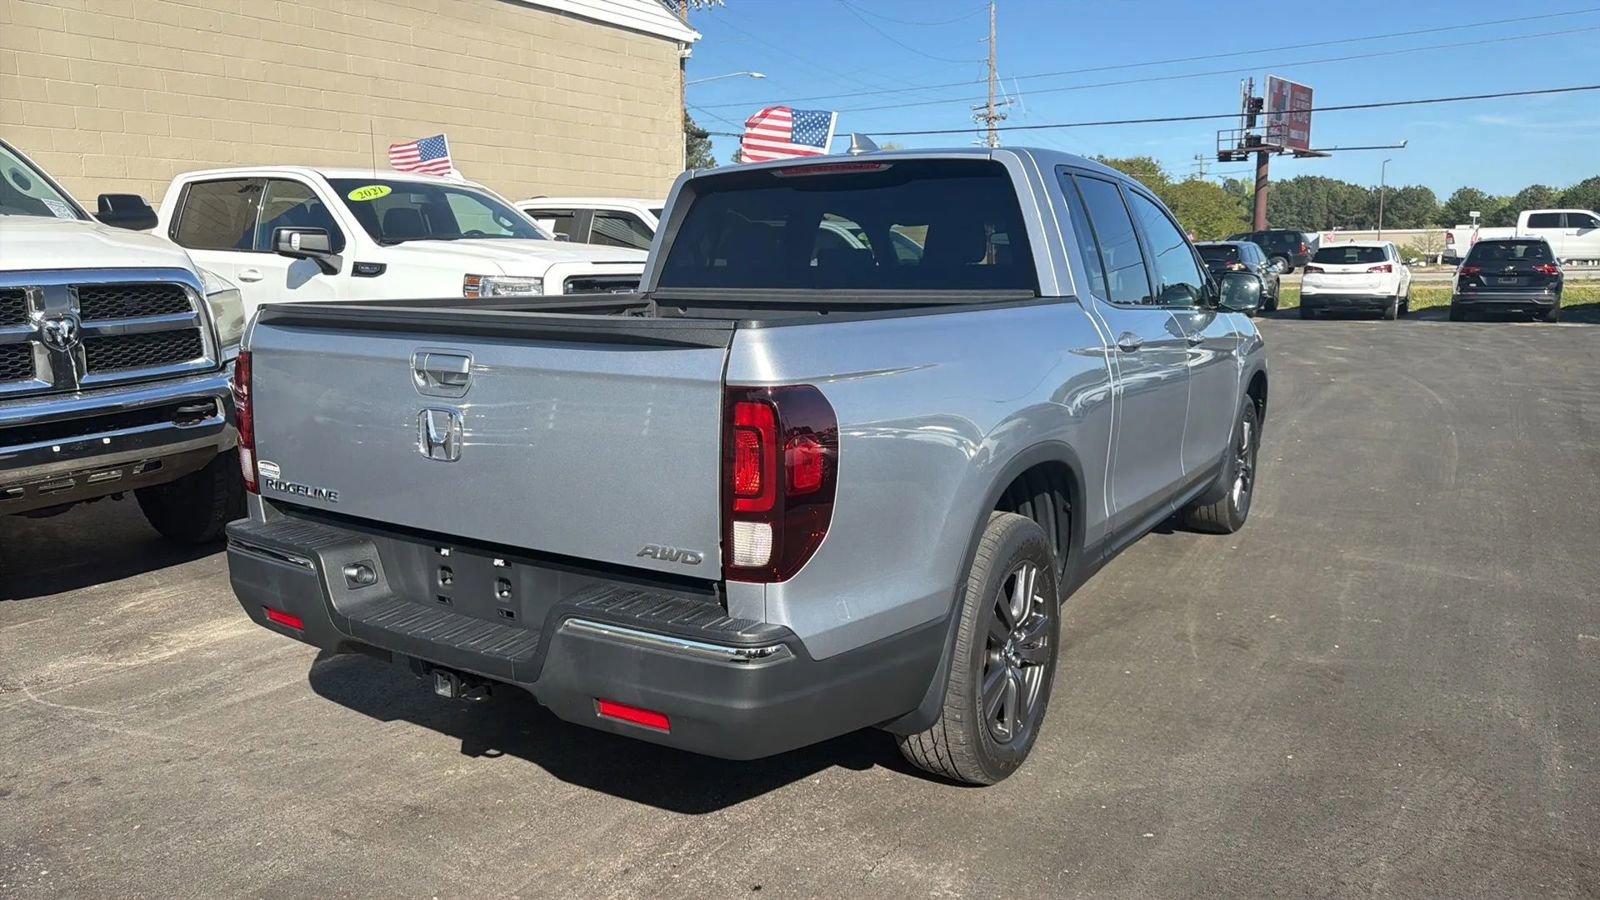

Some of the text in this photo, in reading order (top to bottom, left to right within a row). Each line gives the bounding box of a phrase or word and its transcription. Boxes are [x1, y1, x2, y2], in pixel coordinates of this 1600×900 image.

[356, 186, 384, 200] 2021
[265, 478, 339, 503] RIDGELINE
[636, 544, 704, 566] AWD
